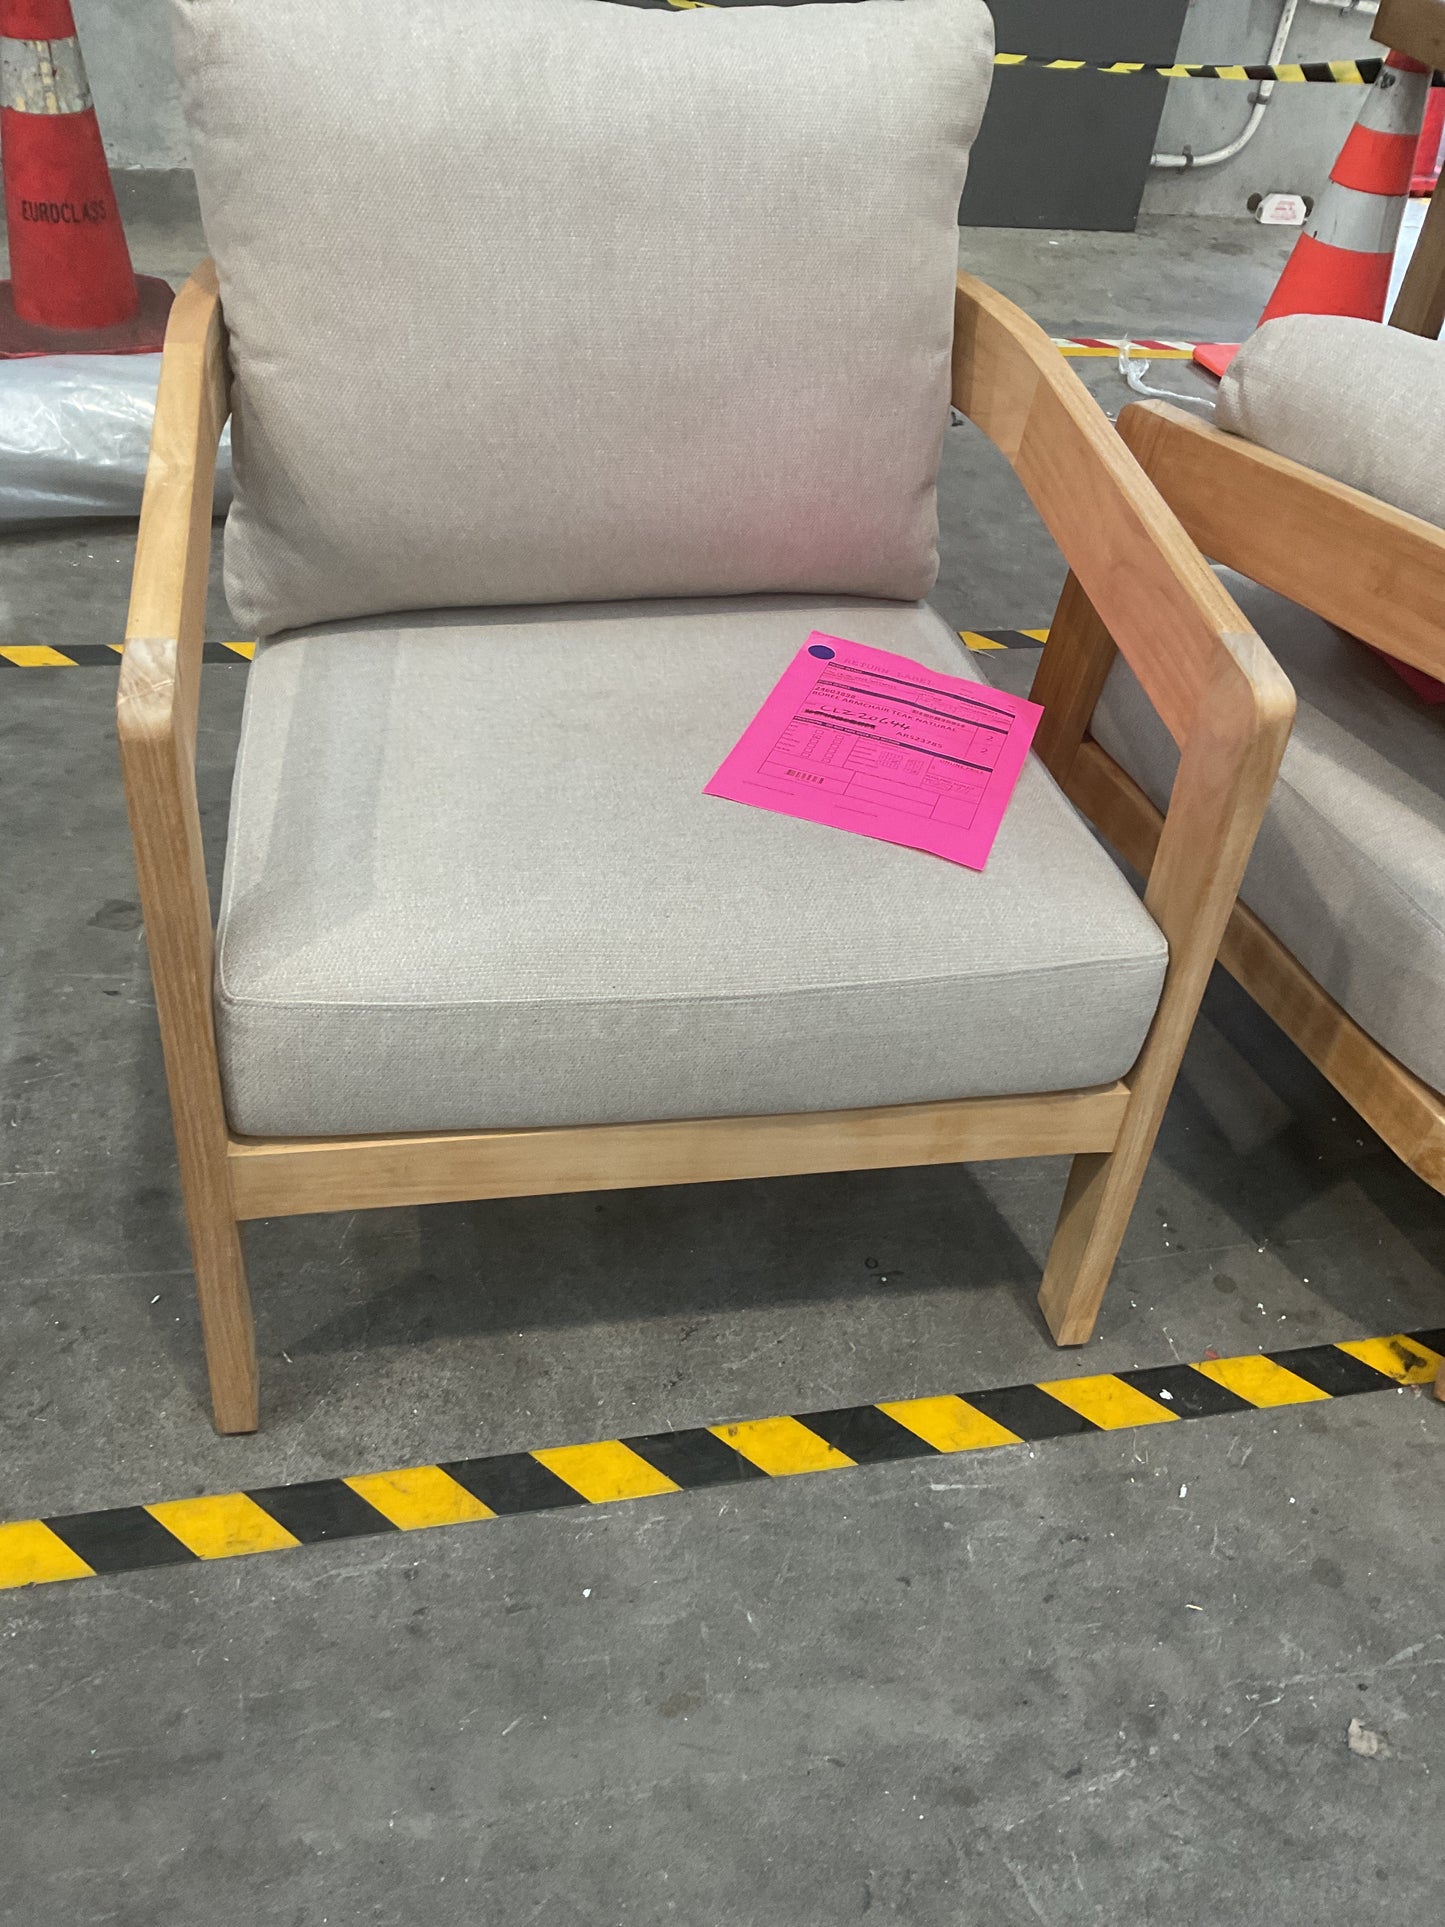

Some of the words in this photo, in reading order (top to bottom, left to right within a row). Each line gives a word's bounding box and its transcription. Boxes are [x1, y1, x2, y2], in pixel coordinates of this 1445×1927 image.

[21, 199, 107, 224] EUROCLASS
[842, 698, 890, 712] ARMCHAIR
[893, 709, 913, 719] TEAK
[915, 717, 956, 732] NATURAL
